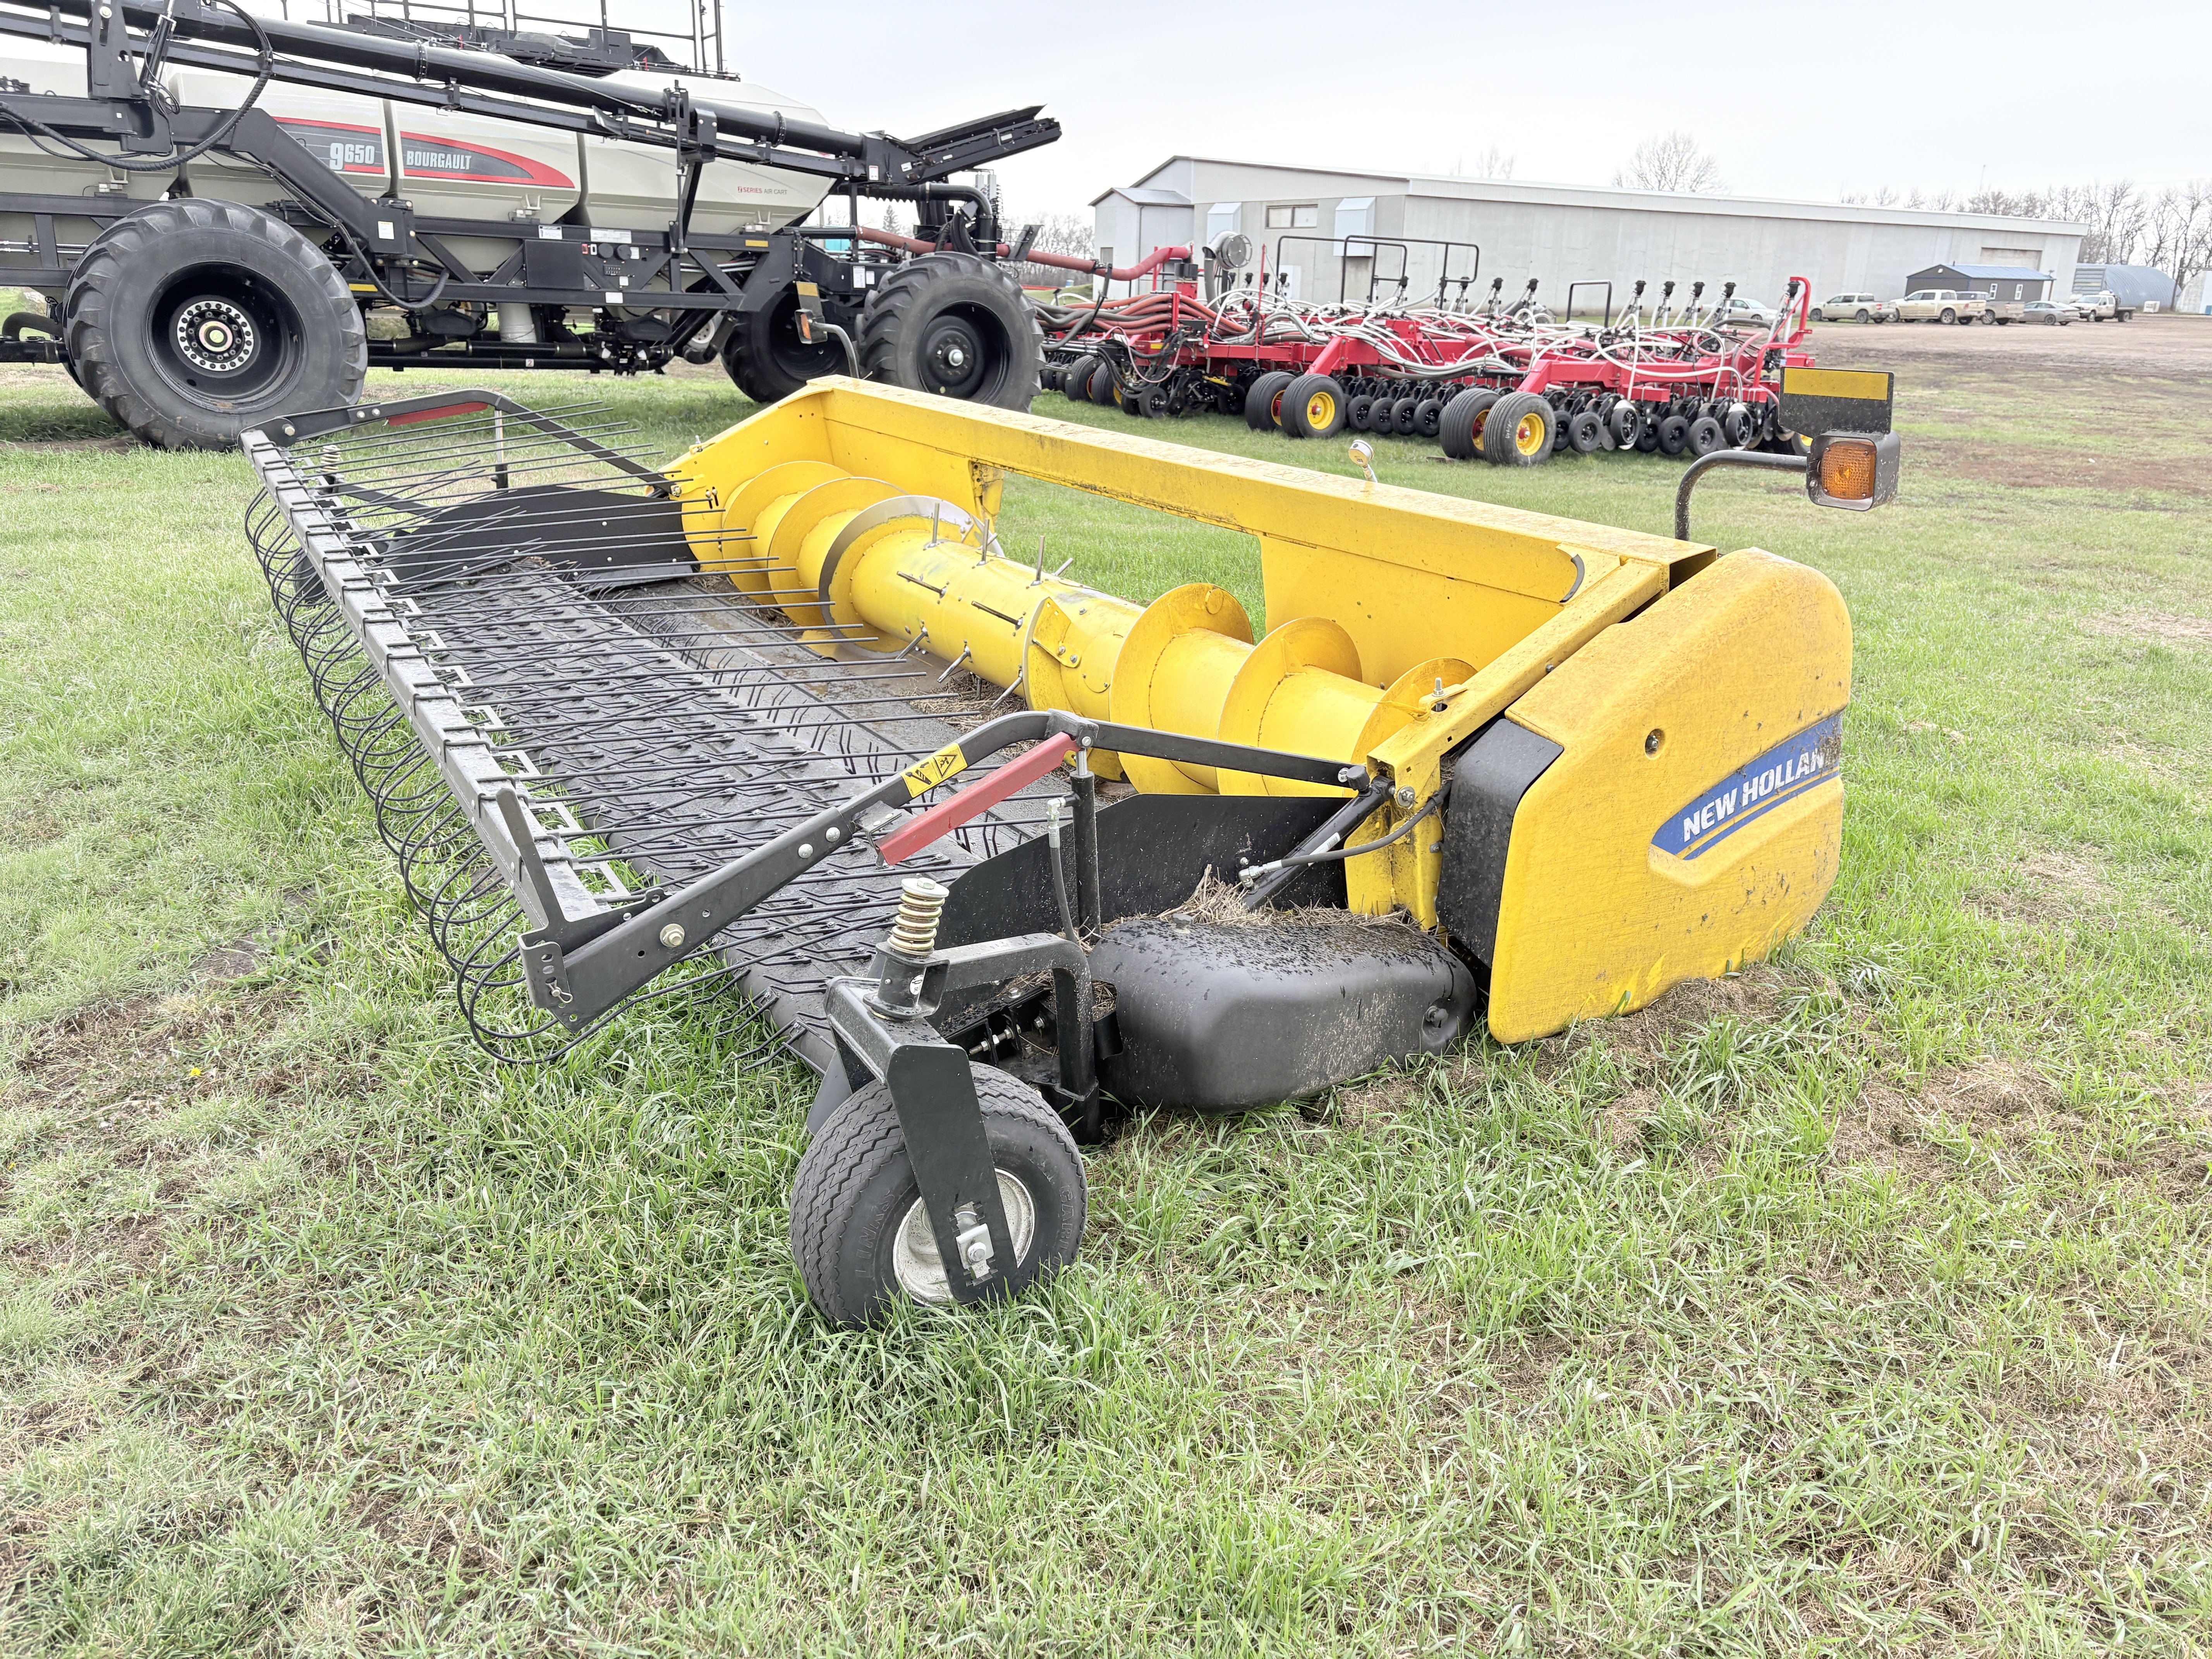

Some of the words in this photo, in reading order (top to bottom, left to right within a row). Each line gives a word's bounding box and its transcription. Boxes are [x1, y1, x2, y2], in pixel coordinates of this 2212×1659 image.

[330, 143, 375, 170] 9650
[407, 151, 472, 170] BOURGAULT
[1683, 788, 1737, 842] NEW
[1743, 747, 1826, 807] HOLLAN
